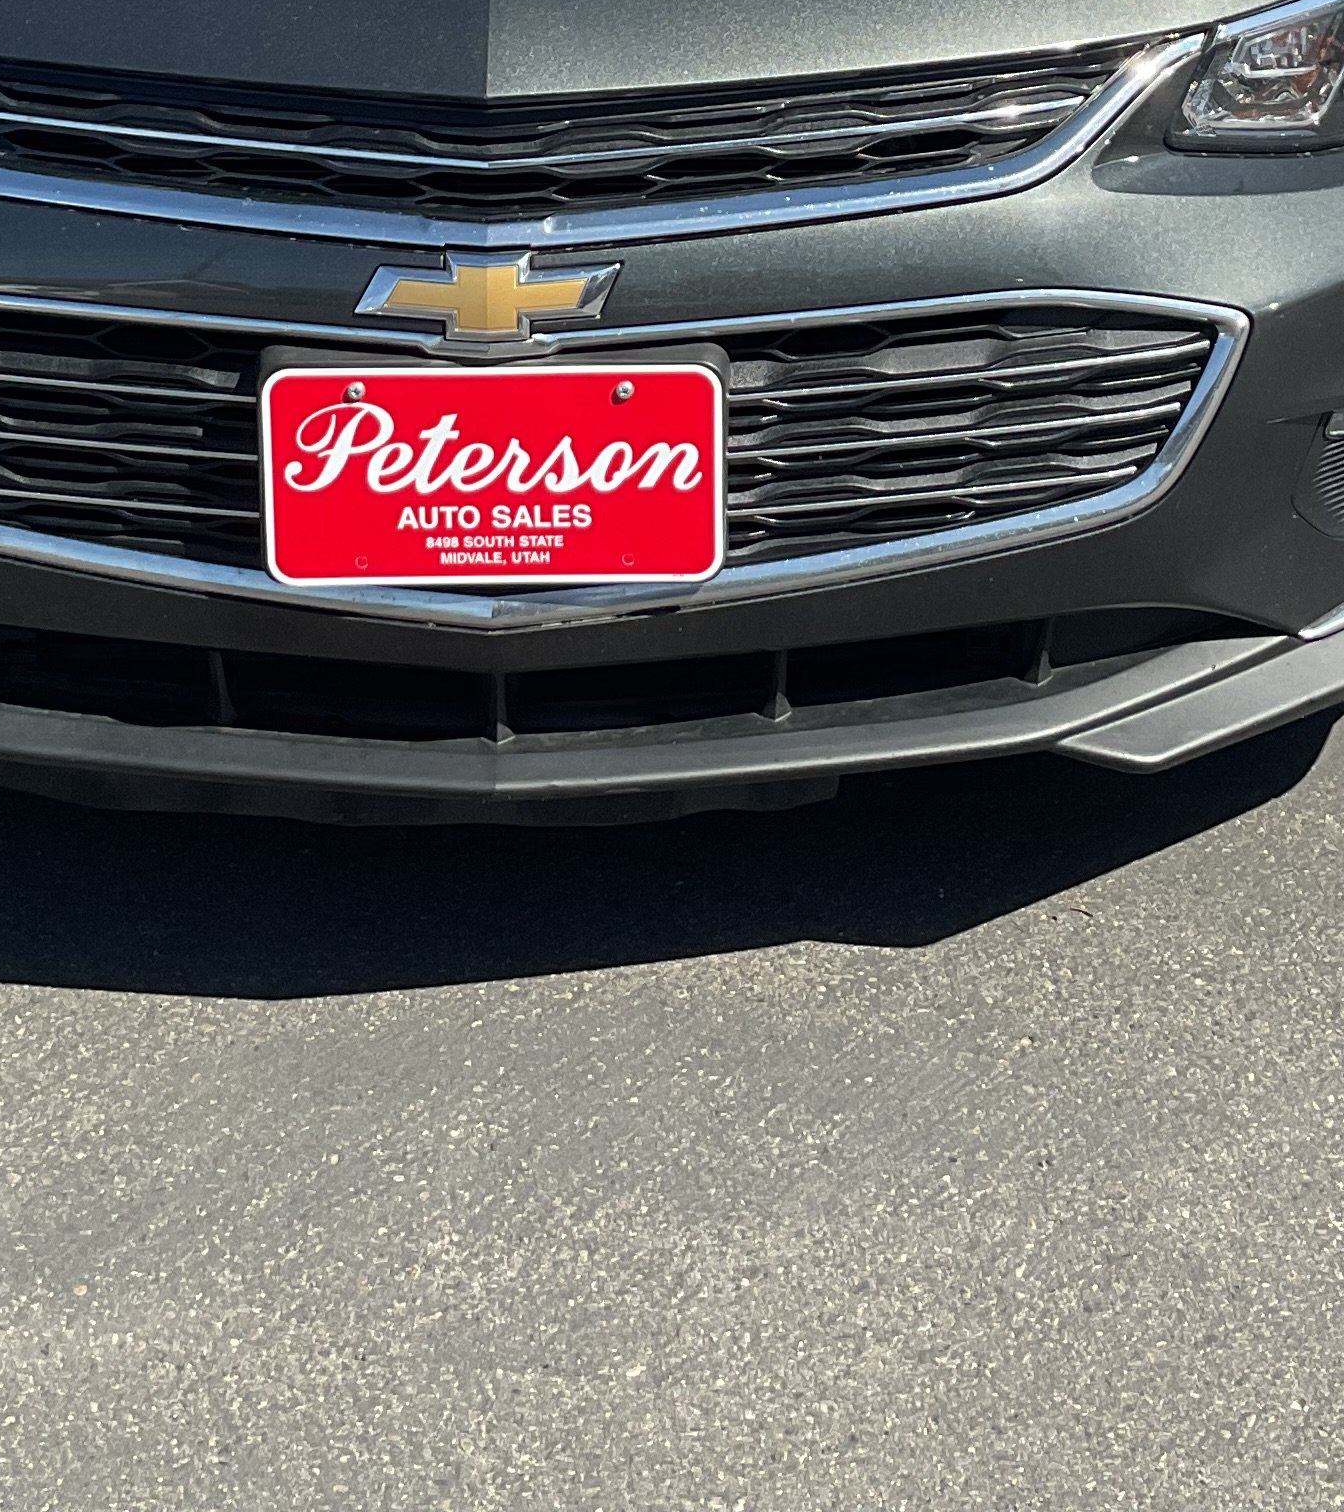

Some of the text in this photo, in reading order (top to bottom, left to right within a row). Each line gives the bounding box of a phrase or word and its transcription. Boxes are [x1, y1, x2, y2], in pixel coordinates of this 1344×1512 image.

[284, 401, 703, 494] Peterson
[397, 504, 593, 530] AUTO SALES
[425, 535, 564, 549] 8498 SOUTH STATE
[440, 551, 551, 565] MIDVALE, UTAH
